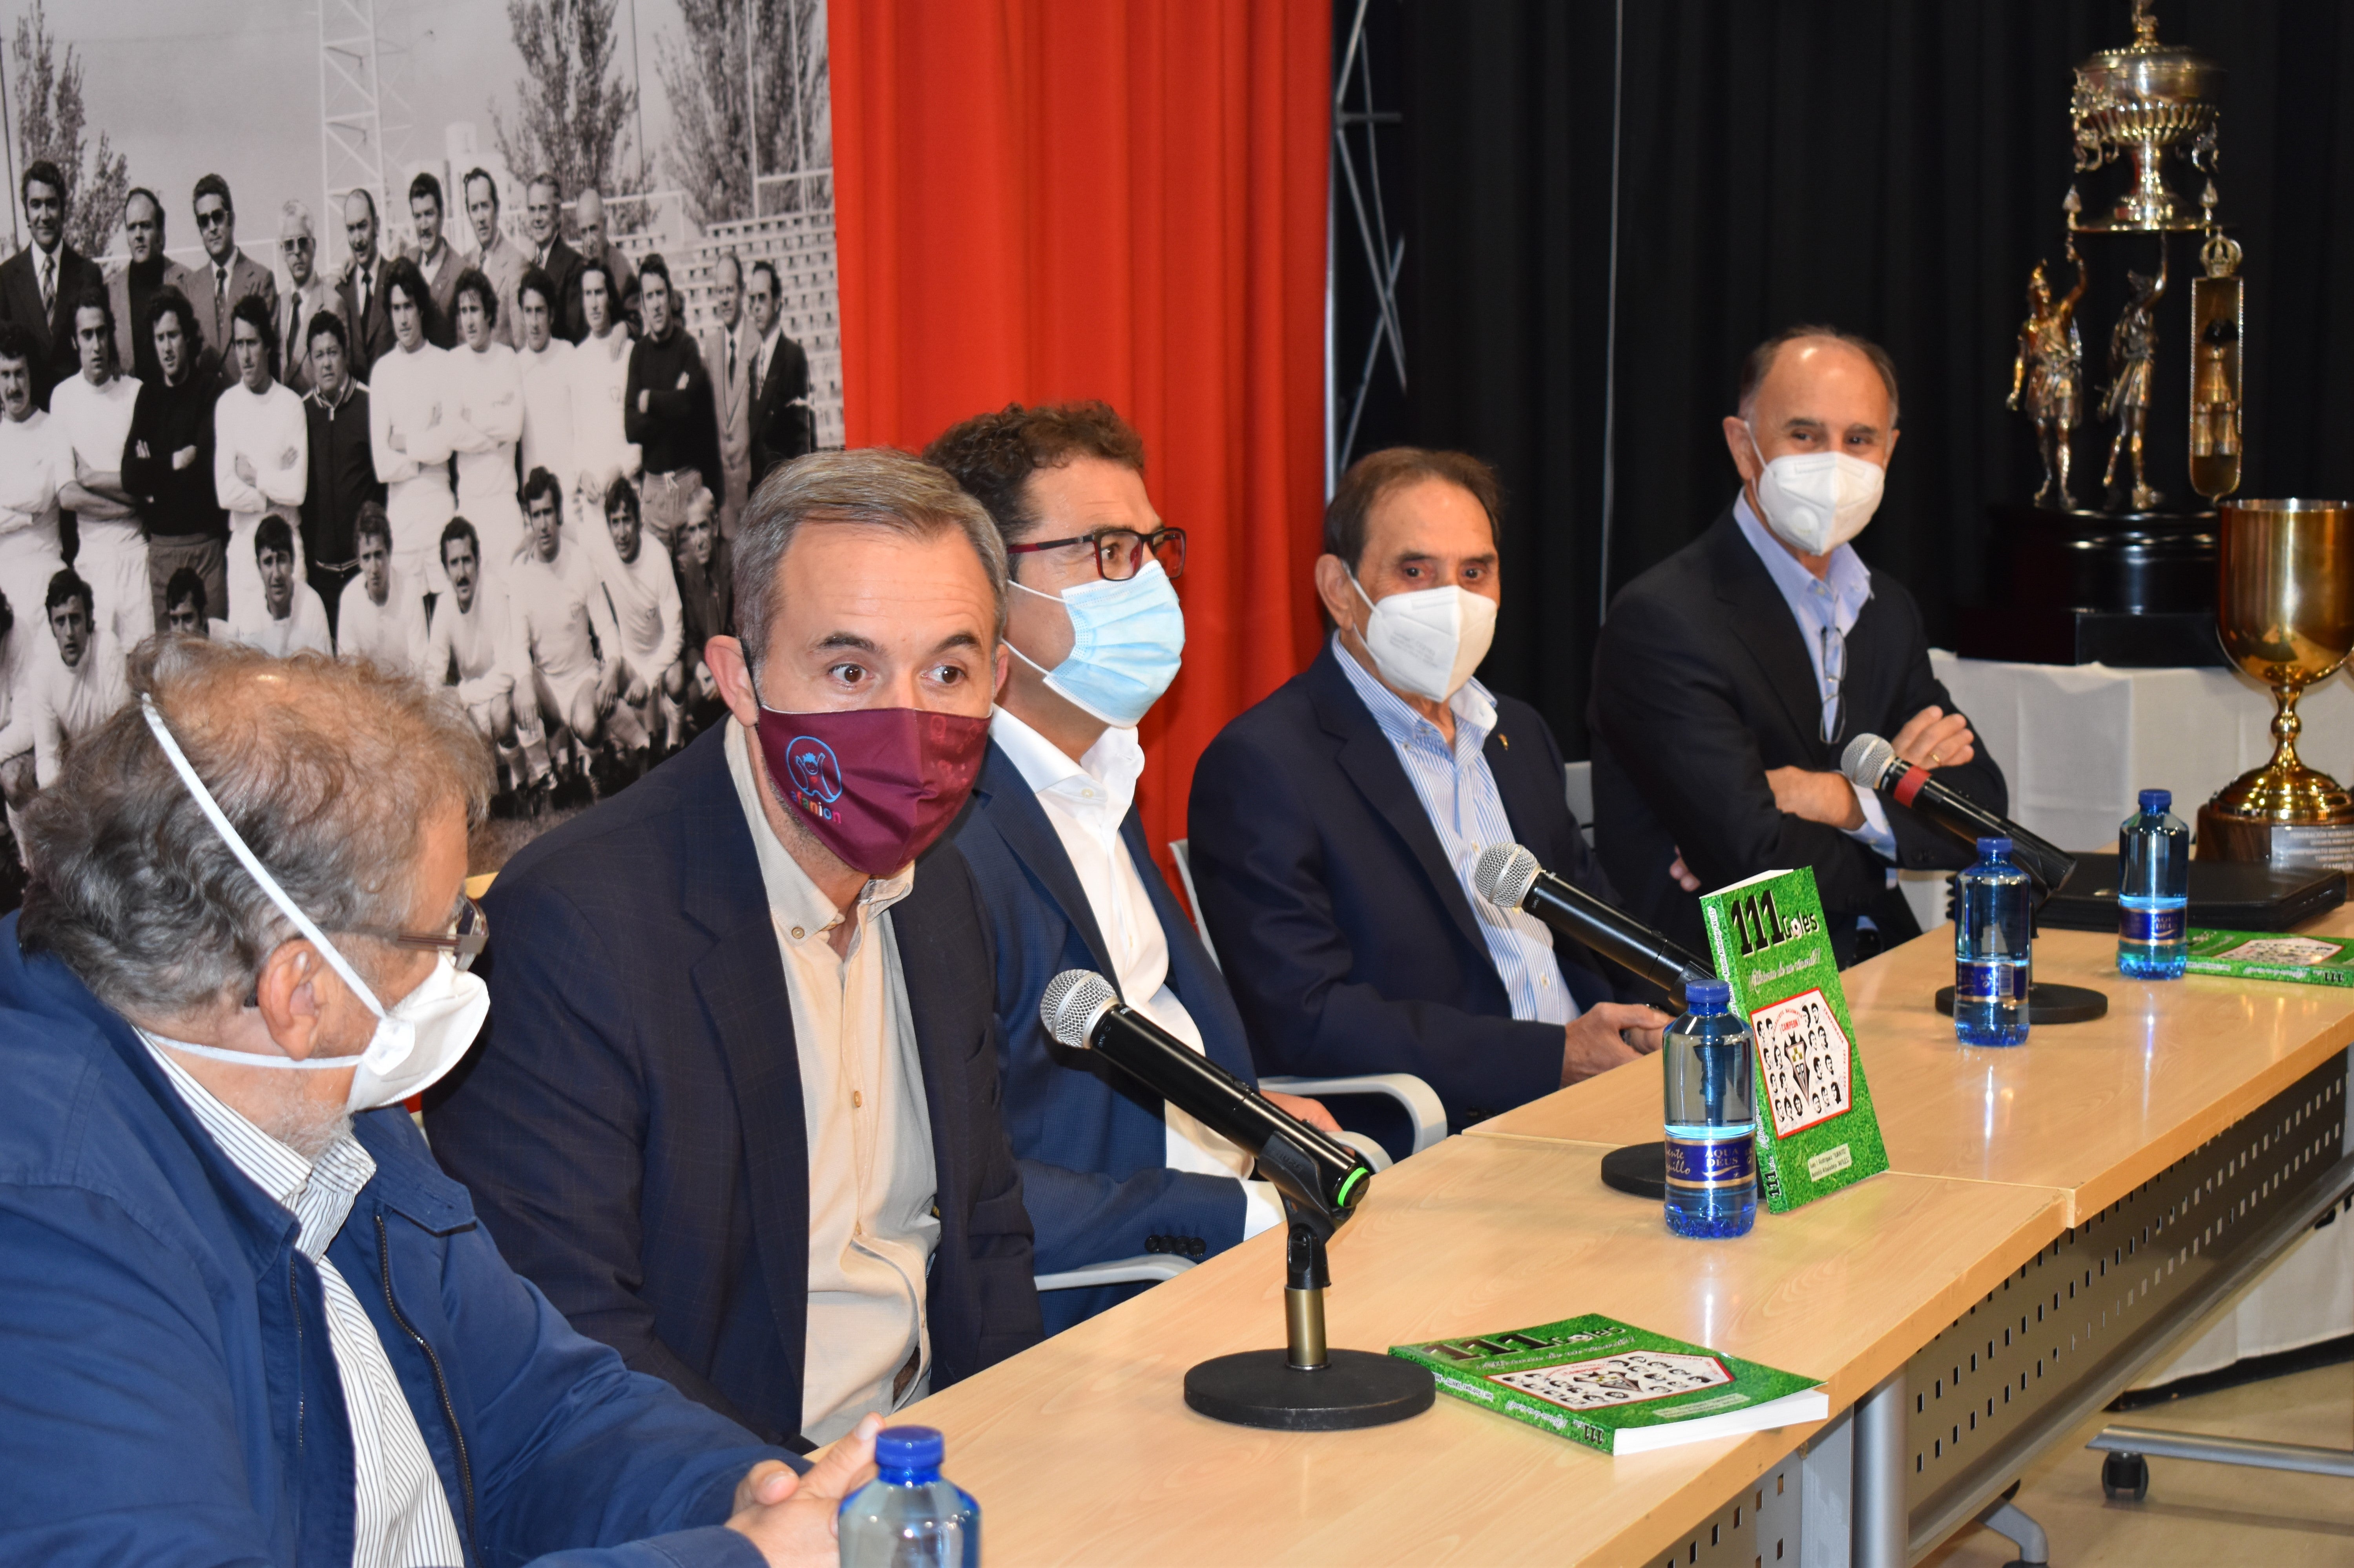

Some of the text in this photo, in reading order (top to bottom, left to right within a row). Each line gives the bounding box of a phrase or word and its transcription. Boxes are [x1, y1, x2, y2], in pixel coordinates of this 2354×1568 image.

[790, 790, 841, 824] afanion
[1731, 890, 1819, 957] 111 Goles
[1715, 929, 1724, 955] Albaladejo
[1721, 952, 1730, 975] Antonio
[1824, 1007, 1844, 1045] TEMPORADA
[1705, 1147, 1739, 1158] AQUA
[1706, 1158, 1739, 1167] DEUS
[1765, 1171, 1782, 1198] 111
[1422, 1333, 1561, 1361] 111
[1584, 1423, 1604, 1444] 111
